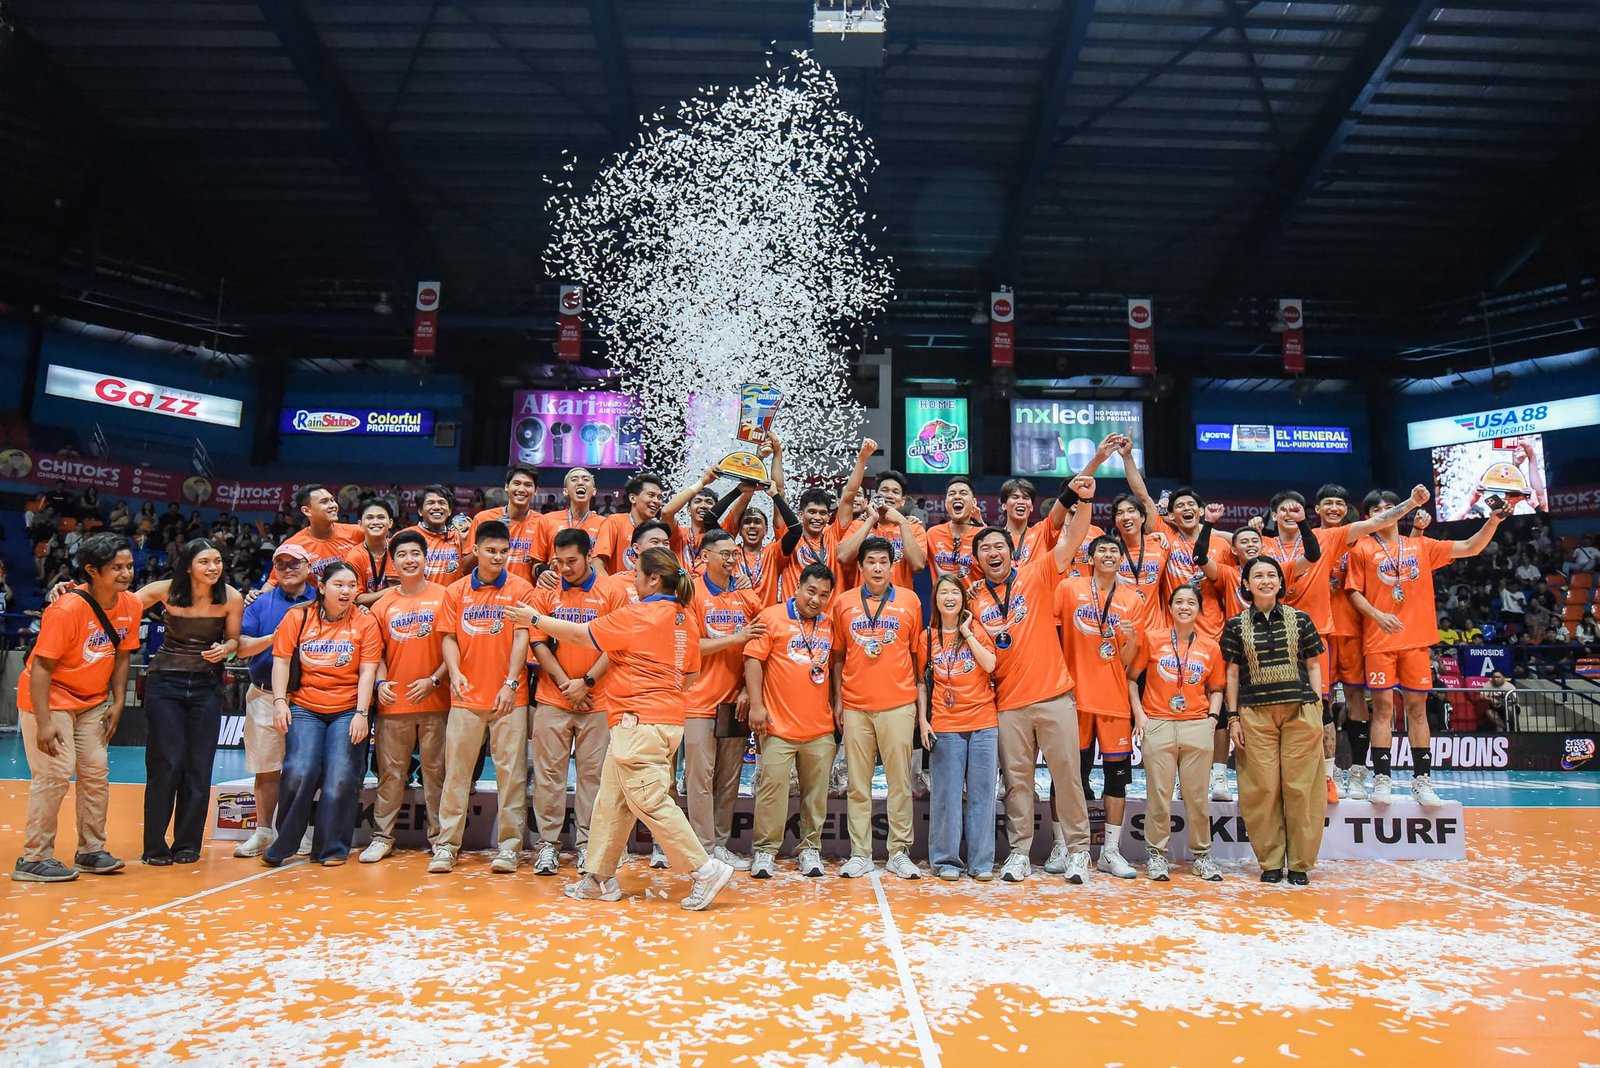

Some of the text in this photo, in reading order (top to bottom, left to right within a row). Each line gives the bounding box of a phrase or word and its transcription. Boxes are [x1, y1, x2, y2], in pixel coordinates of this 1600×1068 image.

[95, 378, 200, 417] Gazz
[521, 393, 596, 416] Akari
[920, 400, 956, 409] HOME
[367, 412, 421, 424] Colorful
[1016, 403, 1095, 425] nxled
[1475, 405, 1548, 429] USA 88
[366, 424, 420, 432] PROTECTION
[1276, 430, 1290, 440] EL
[1294, 431, 1348, 441] HENERAL
[1478, 422, 1536, 438] lubricants
[910, 441, 968, 455] CHAMELEONS
[1277, 441, 1324, 449] ALL-PURPOSE
[39, 458, 121, 482] CHITOK'S
[217, 484, 282, 499] CHITOK'S
[1380, 558, 1419, 573] CHAPIONS
[302, 644, 354, 653] CHAMPIONS
[1160, 659, 1205, 673] CHAIONS
[1480, 657, 1495, 677] A
[1369, 672, 1386, 685] 23
[1345, 817, 1457, 844] TURF
